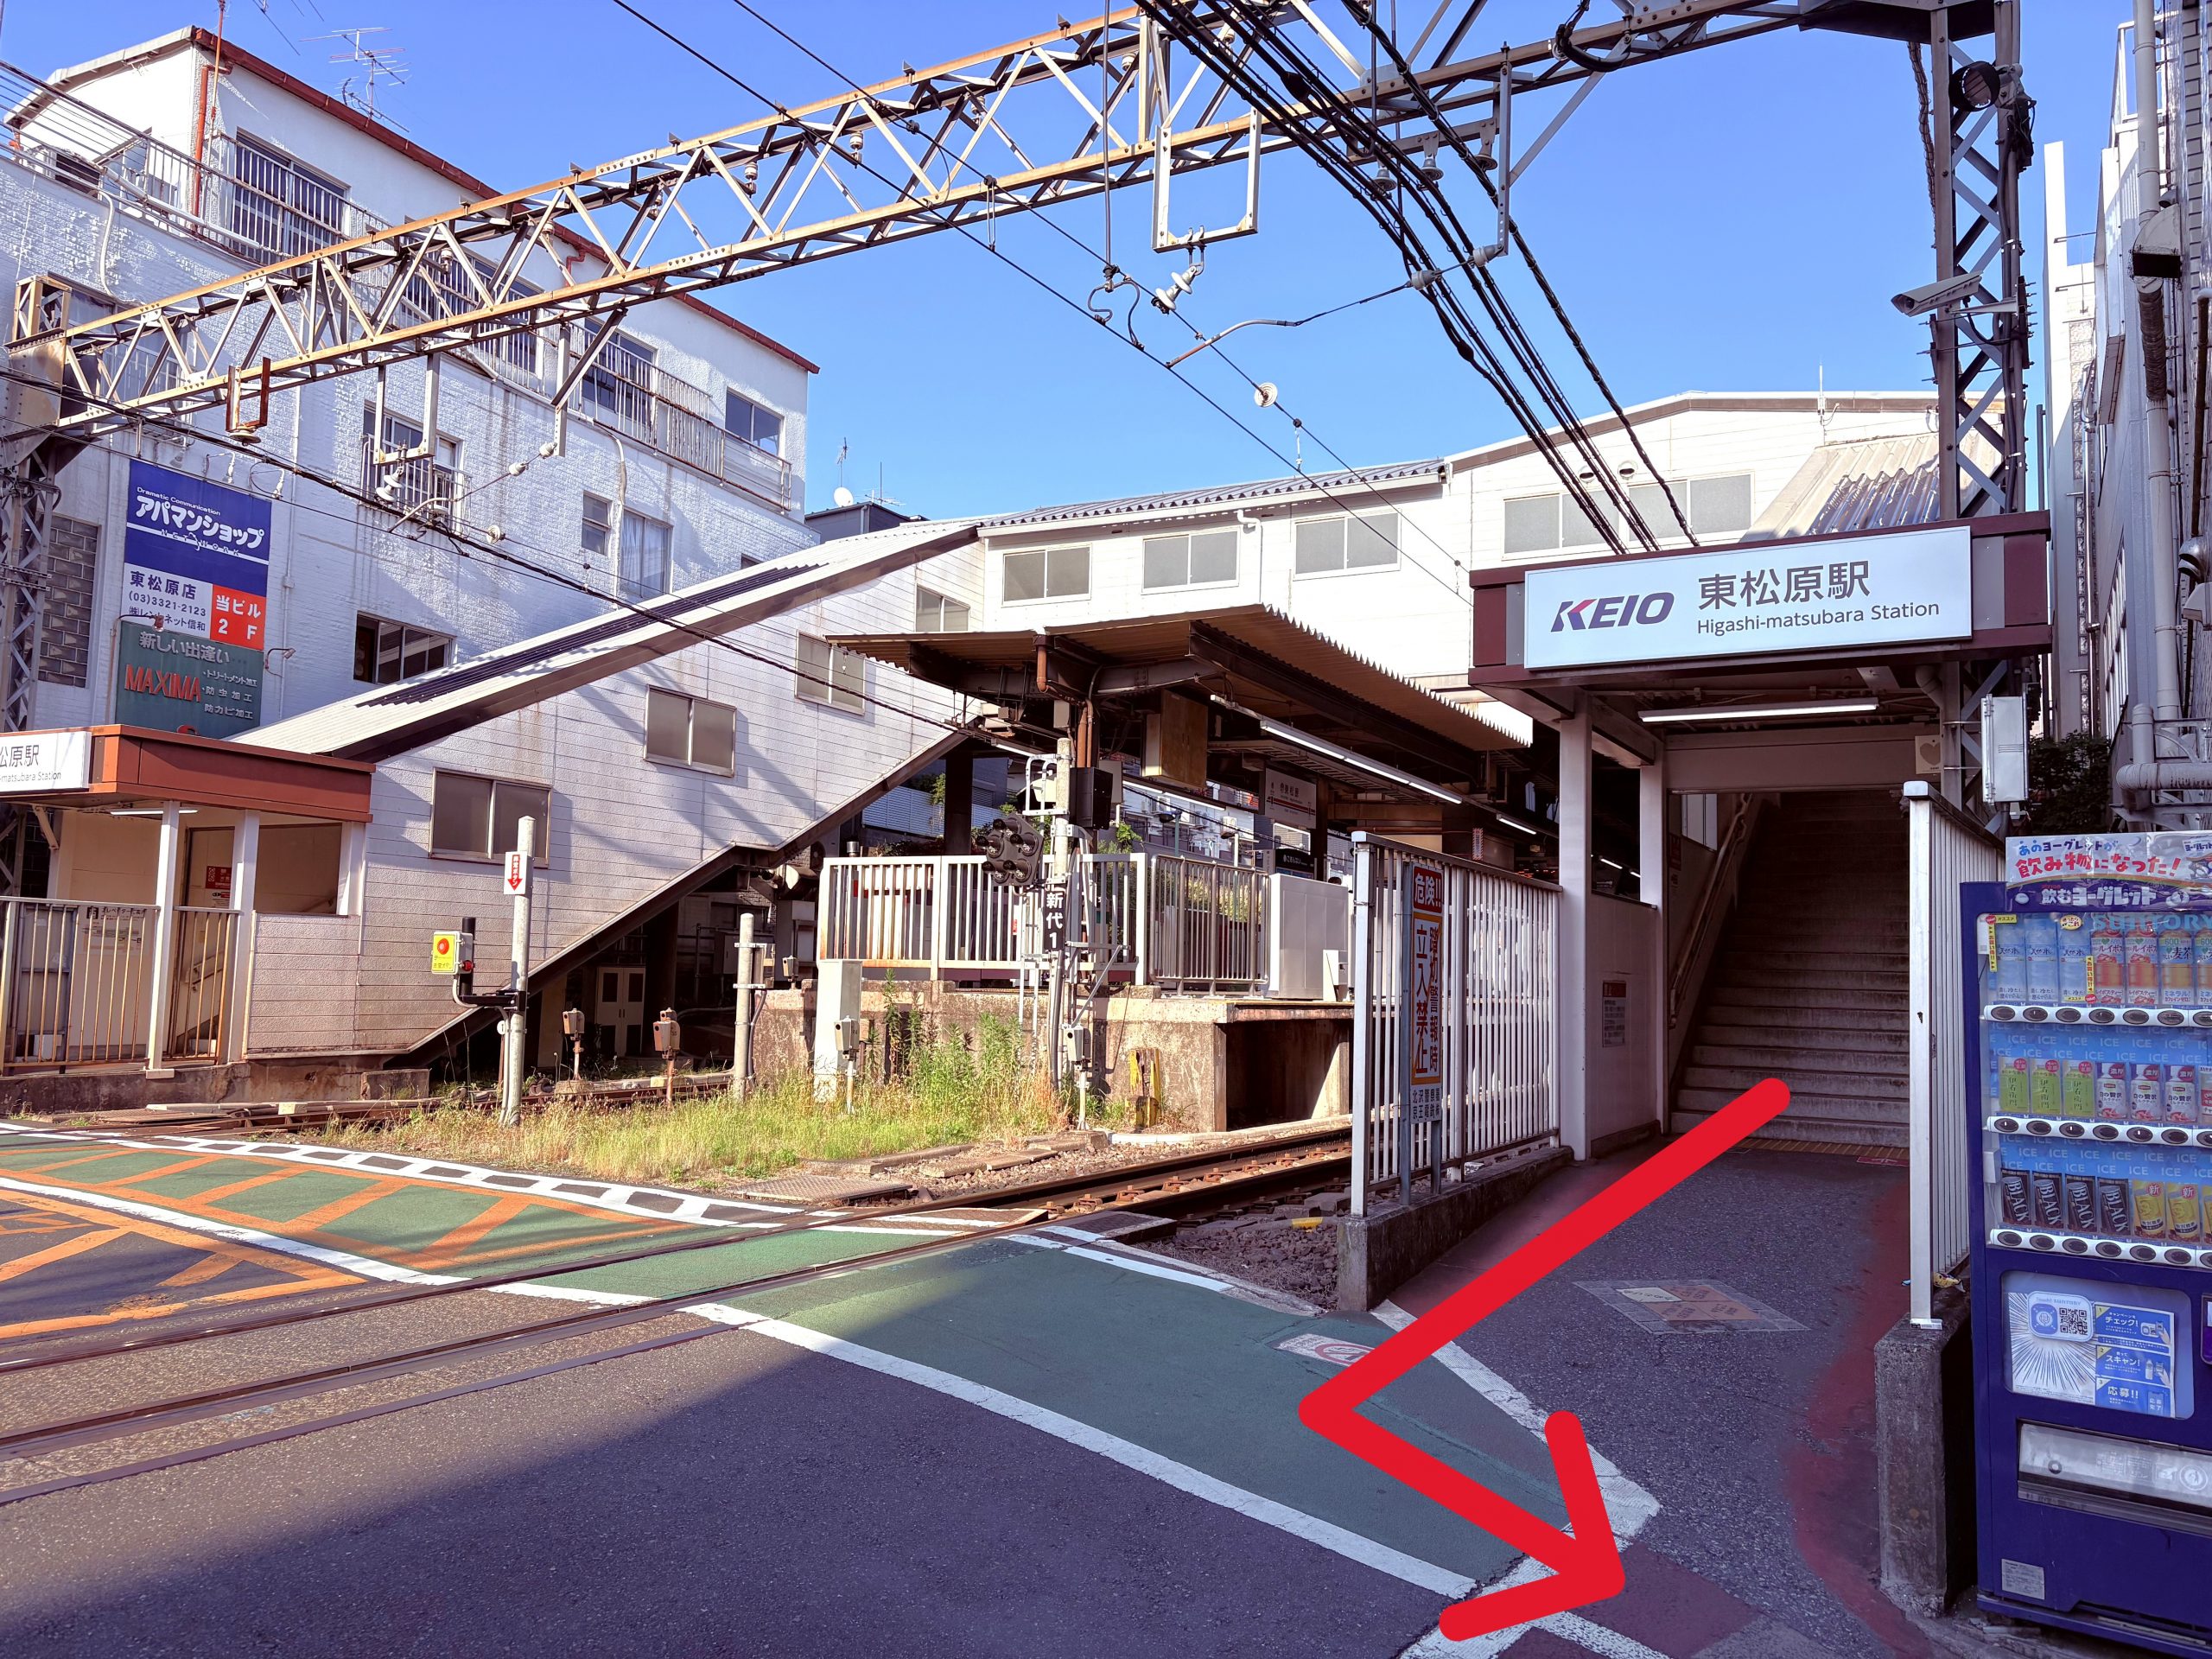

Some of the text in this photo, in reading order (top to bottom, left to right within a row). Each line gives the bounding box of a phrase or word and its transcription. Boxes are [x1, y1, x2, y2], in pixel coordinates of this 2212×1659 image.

[137, 486, 221, 516] Dramatic Communication
[136, 495, 265, 549] アパマンショップ
[130, 571, 197, 601] 東松原店
[1698, 560, 1871, 612] 東松原駅
[129, 590, 207, 617] (03)3321-2123
[216, 594, 262, 619] 当ビル
[1550, 592, 1675, 632] KEIO
[1697, 602, 1940, 637] Higashi-matsubara Station
[124, 664, 201, 702] MAXIMA
[204, 703, 253, 720] 防カビ加工
[37, 771, 61, 781] Station
[2015, 851, 2182, 879] 飲み物になった!
[1414, 872, 1441, 907] 危険!!
[2041, 885, 2157, 906] 飲むヨーグレット
[1046, 892, 1064, 949] 新代1
[1416, 924, 1428, 1074] 立入禁止
[1429, 926, 1439, 1072] 踏切警報時
[2008, 1035, 2026, 1044] ICE
[2038, 1036, 2057, 1045] ICE
[2069, 1037, 2088, 1046] ICE
[2100, 1038, 2120, 1047] ICE
[2132, 1039, 2152, 1048] ICE
[2164, 1039, 2185, 1049] ICE
[1993, 1047, 2012, 1056] ICE
[2024, 1049, 2042, 1058] ICE
[2054, 1050, 2073, 1058] ICE
[2085, 1051, 2105, 1060] ICE
[2116, 1052, 2136, 1061] ICE
[2149, 1053, 2169, 1062] ICE
[2181, 1054, 2202, 1064] ICE
[2018, 1147, 2037, 1157] ICE
[2049, 1148, 2069, 1158] ICE
[2081, 1150, 2100, 1159] ICE
[2112, 1152, 2132, 1160] ICE
[2144, 1153, 2164, 1162] ICE
[2177, 1154, 2197, 1163] ICE
[2003, 1160, 2023, 1169] ICE
[2035, 1162, 2054, 1171] ICE
[2066, 1163, 2085, 1173] ICE
[2097, 1165, 2117, 1173] ICE
[2129, 1166, 2149, 1175] ICE
[2161, 1167, 2182, 1177] ICE
[2195, 1168, 2212, 1178] ICE
[2148, 1185, 2159, 1195] 新
[2183, 1187, 2194, 1198] 新
[2006, 1180, 2030, 1222] BLACK
[2039, 1183, 2063, 1225] BLACK
[2072, 1185, 2095, 1229] BLACK
[2105, 1189, 2129, 1232] BLACK
[2105, 1316, 2139, 1327] チェック!
[2106, 1355, 2140, 1367] スキャン!
[2108, 1386, 2139, 1399] 応募!!
